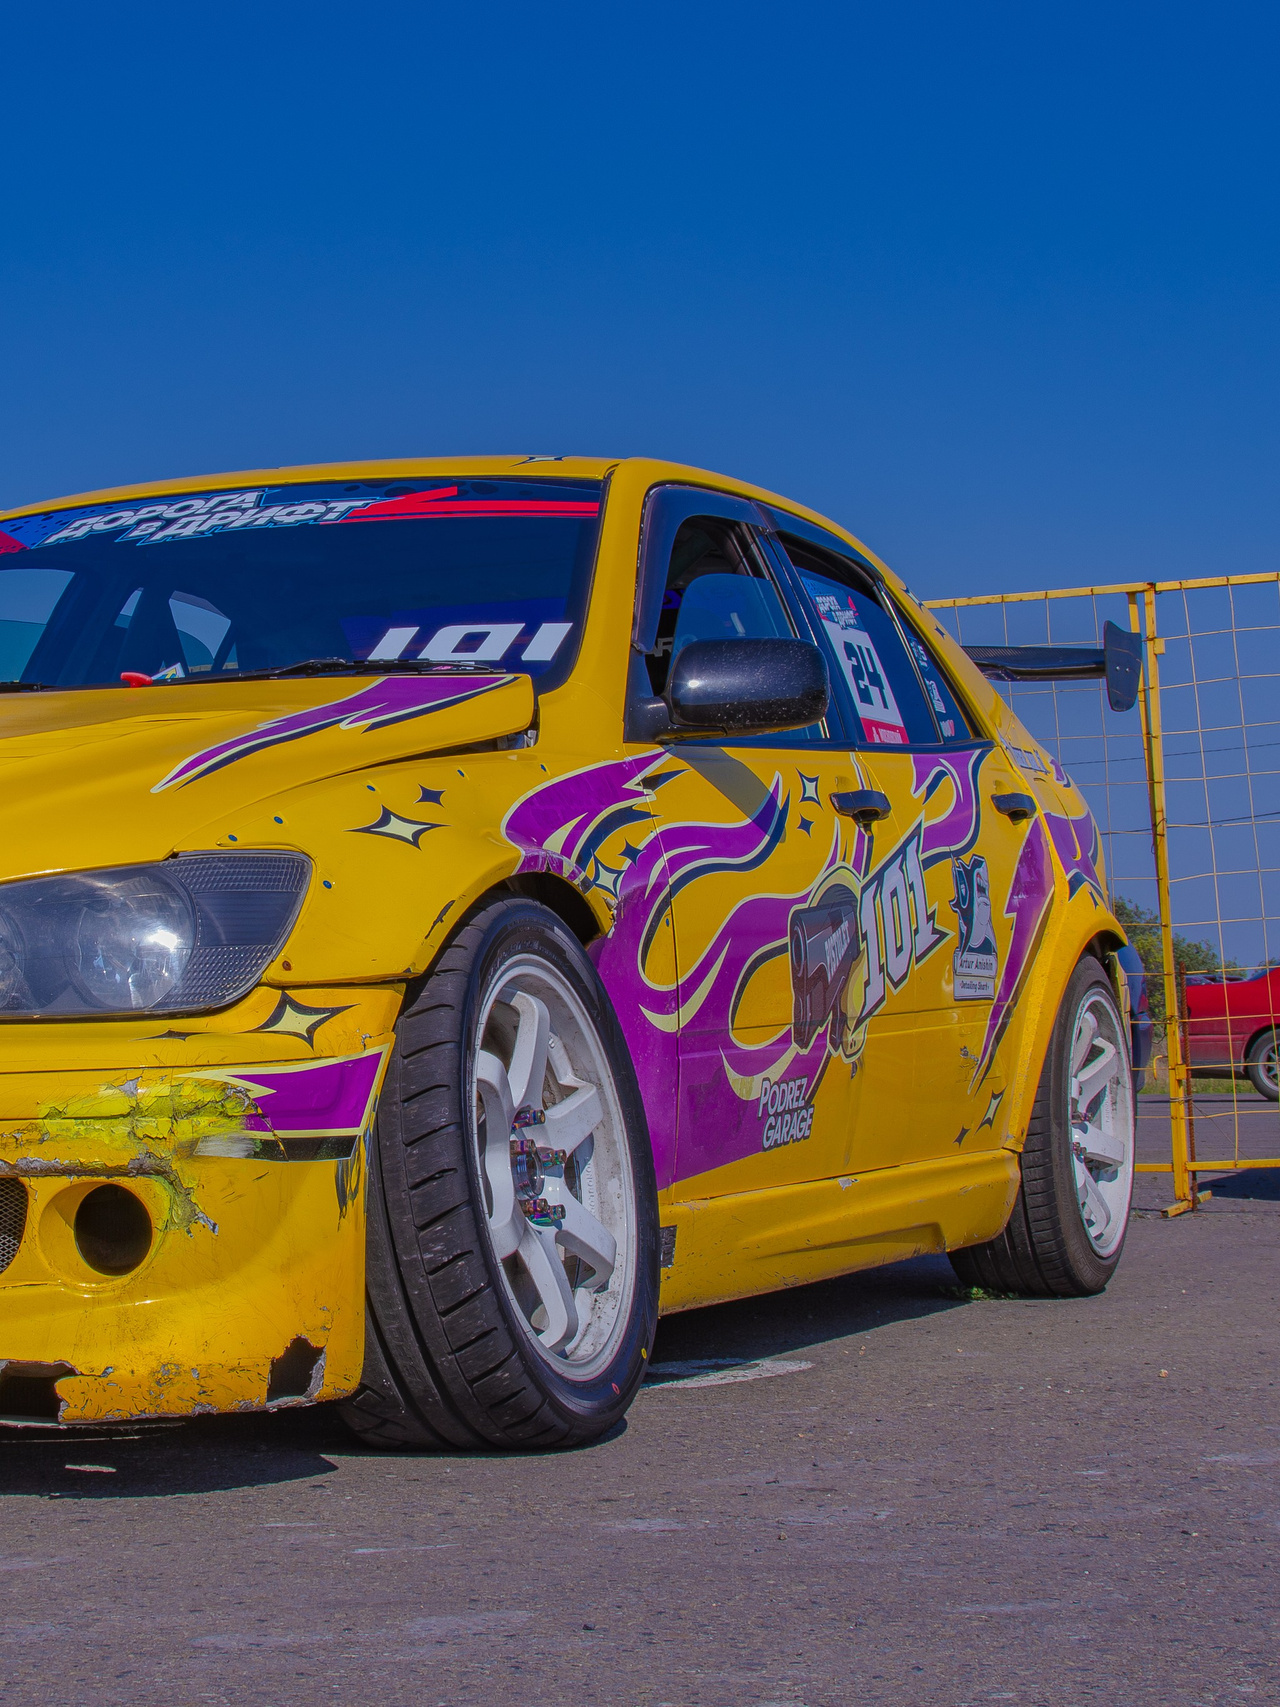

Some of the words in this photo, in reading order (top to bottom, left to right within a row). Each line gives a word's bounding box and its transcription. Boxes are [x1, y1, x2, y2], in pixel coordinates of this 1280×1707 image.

[45, 491, 263, 544] ДОРОГА
[149, 499, 375, 542] ДРИФТ
[367, 622, 573, 661] 101
[843, 641, 889, 710] 24
[860, 835, 940, 1018] 101
[758, 1077, 808, 1118] PODREZ
[763, 1107, 814, 1148] GARAGE
